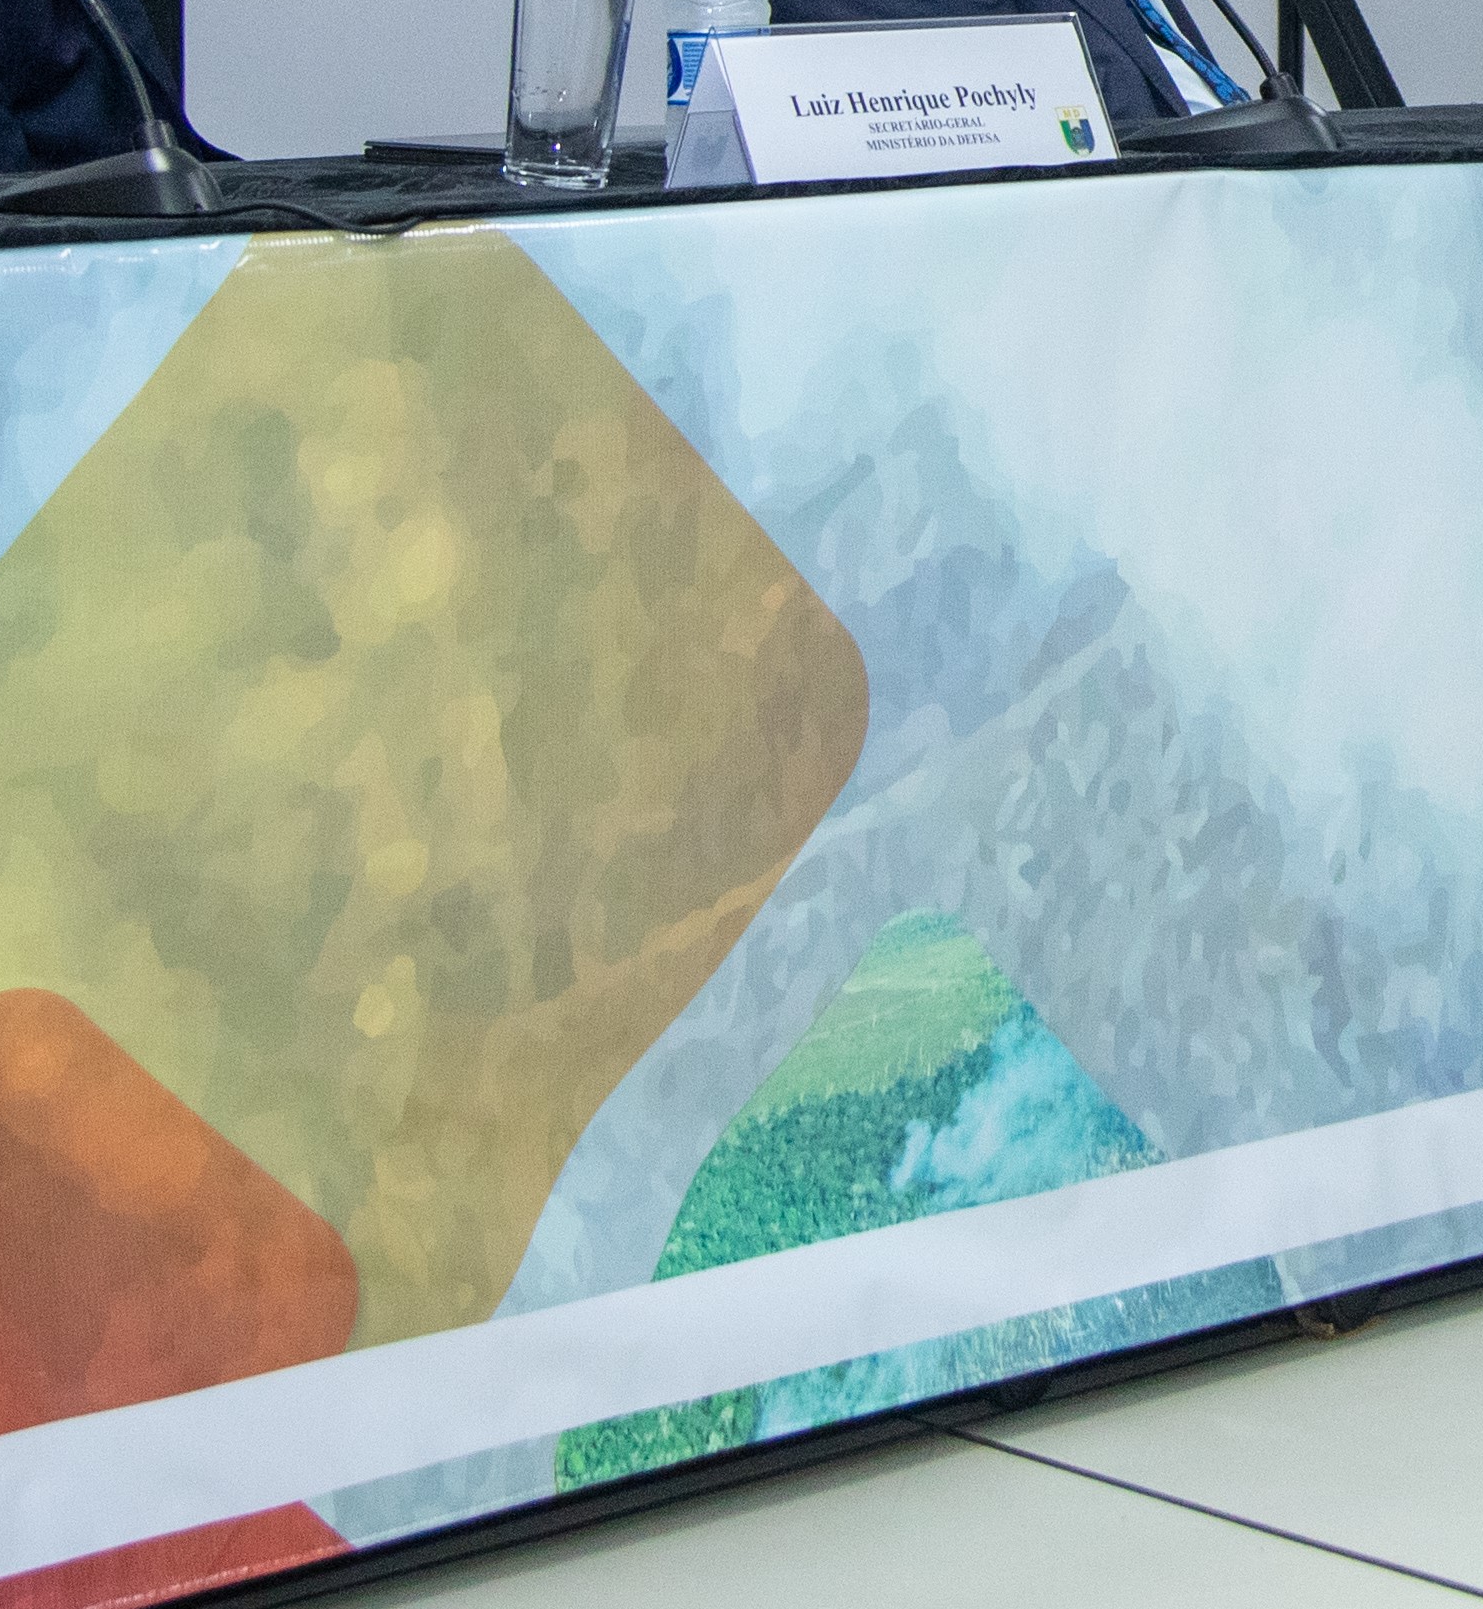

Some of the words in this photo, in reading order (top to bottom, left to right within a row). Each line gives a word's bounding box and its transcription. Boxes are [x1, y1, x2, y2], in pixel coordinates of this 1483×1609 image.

[791, 93, 845, 118] Luiz
[847, 88, 951, 116] Henrique
[954, 82, 1037, 112] Pochyly
[868, 115, 986, 134] SECRETÁRIO-GERAL
[866, 136, 937, 152] MINISTÉRIO
[938, 135, 955, 147] DA
[957, 132, 1001, 146] DEFESA
